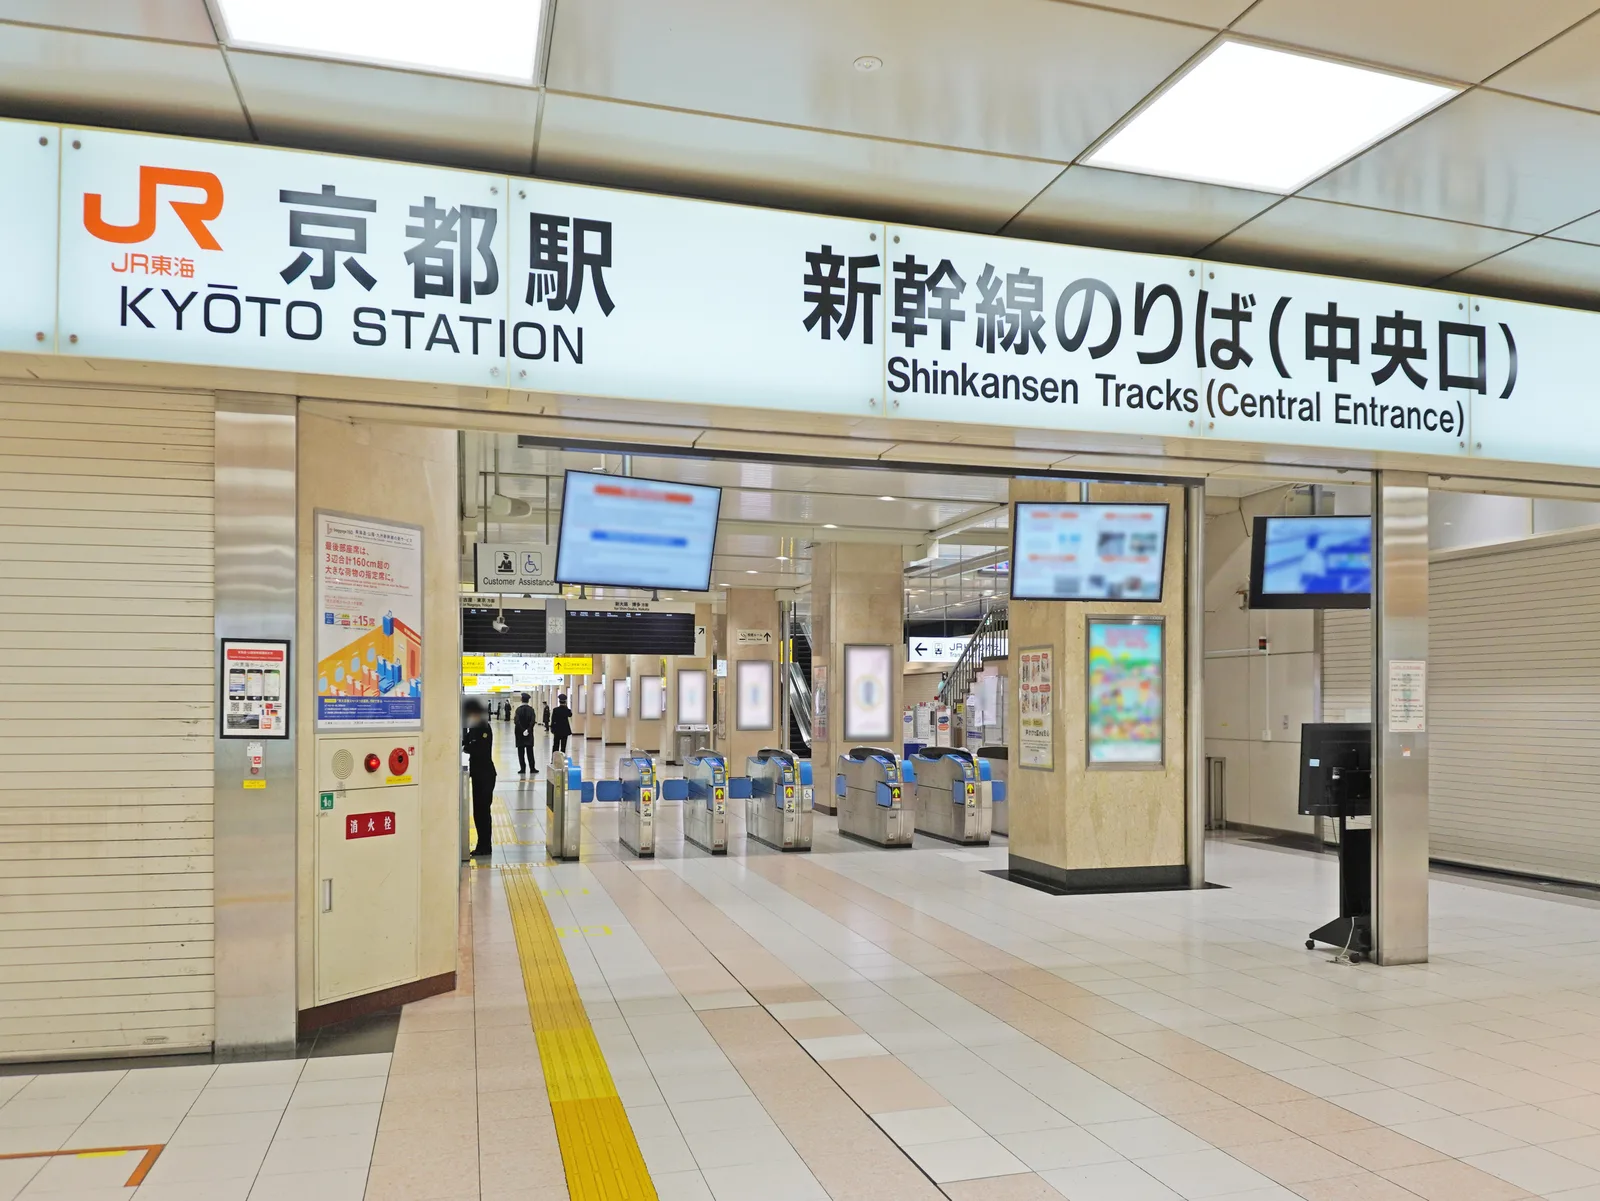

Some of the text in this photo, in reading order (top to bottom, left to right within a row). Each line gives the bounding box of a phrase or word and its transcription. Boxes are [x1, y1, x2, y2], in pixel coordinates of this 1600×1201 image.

[83, 165, 225, 251] JR
[111, 253, 195, 279] JR東海
[279, 185, 616, 318] 京都駅
[352, 306, 585, 365] STATION
[887, 356, 1466, 438] Shinkansen Tracks (Central Entrance)
[483, 576, 555, 587] Customer Assistance
[350, 815, 392, 834] 消火栓
